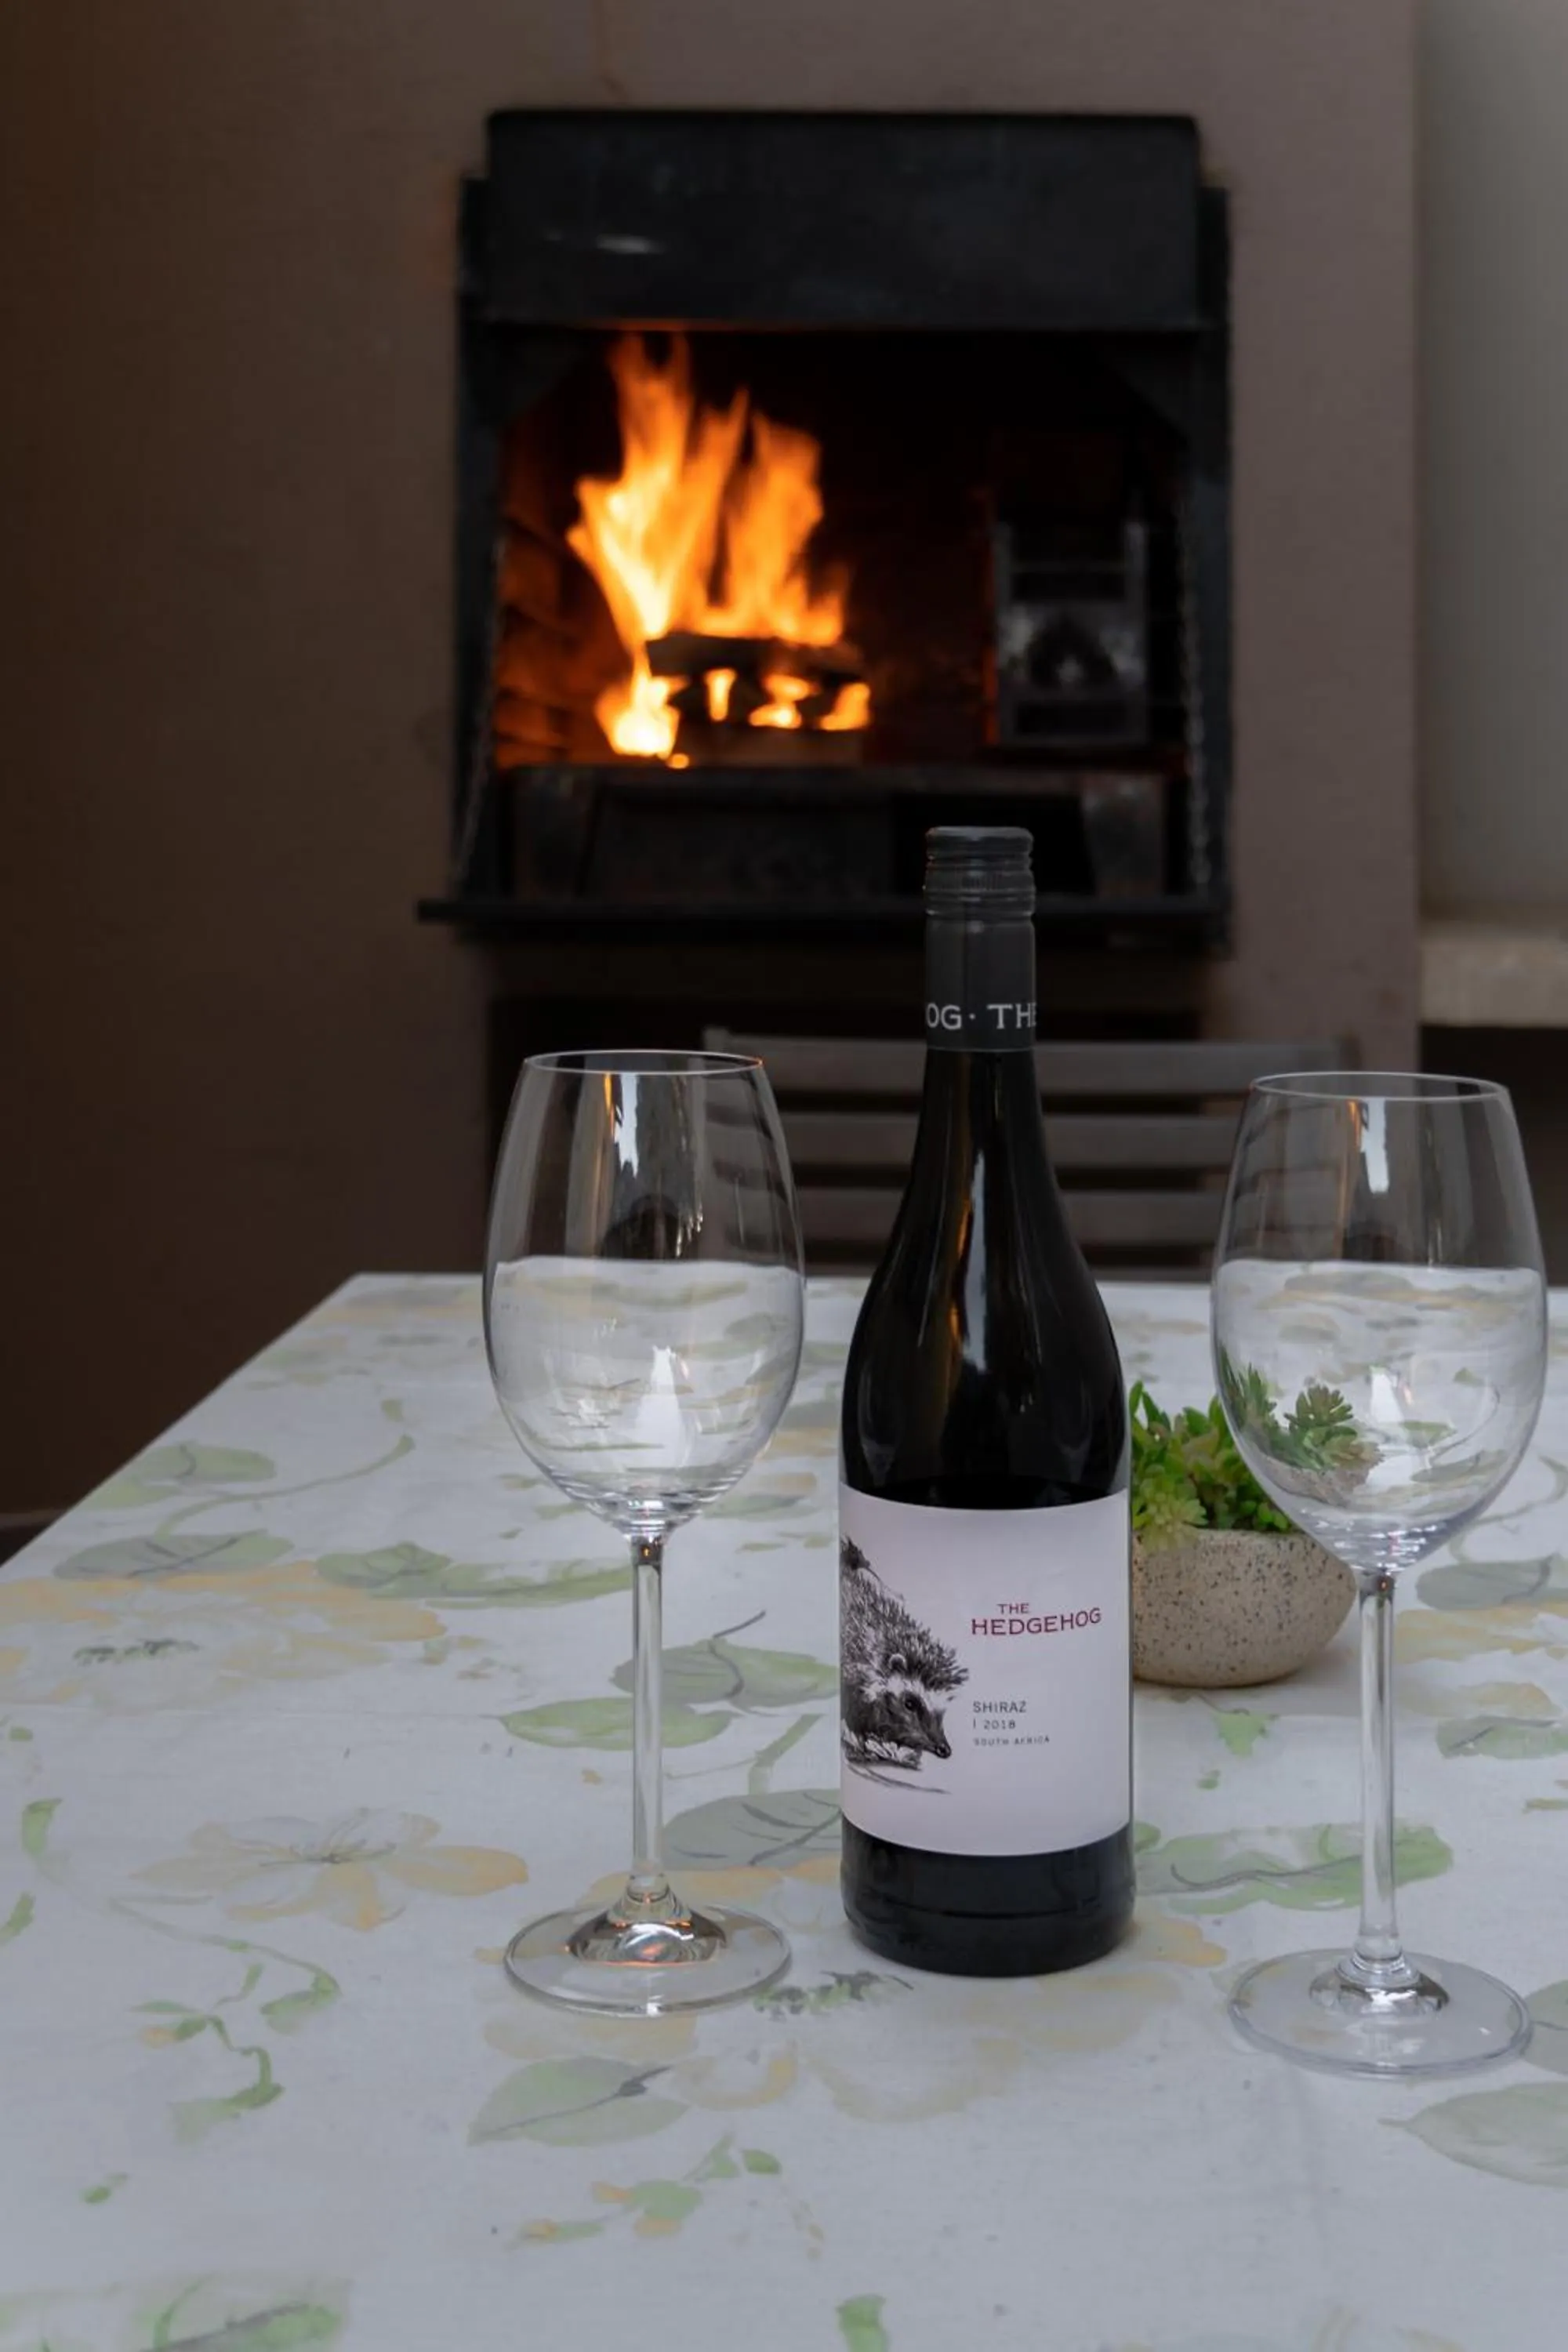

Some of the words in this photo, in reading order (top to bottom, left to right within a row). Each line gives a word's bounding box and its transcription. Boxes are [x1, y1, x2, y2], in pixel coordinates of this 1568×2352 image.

[997, 1602, 1029, 1614] THE
[971, 1607, 1102, 1635] HEDGEHOG
[973, 1700, 1026, 1713] SHIRAZ
[984, 1719, 1015, 1730] 2018
